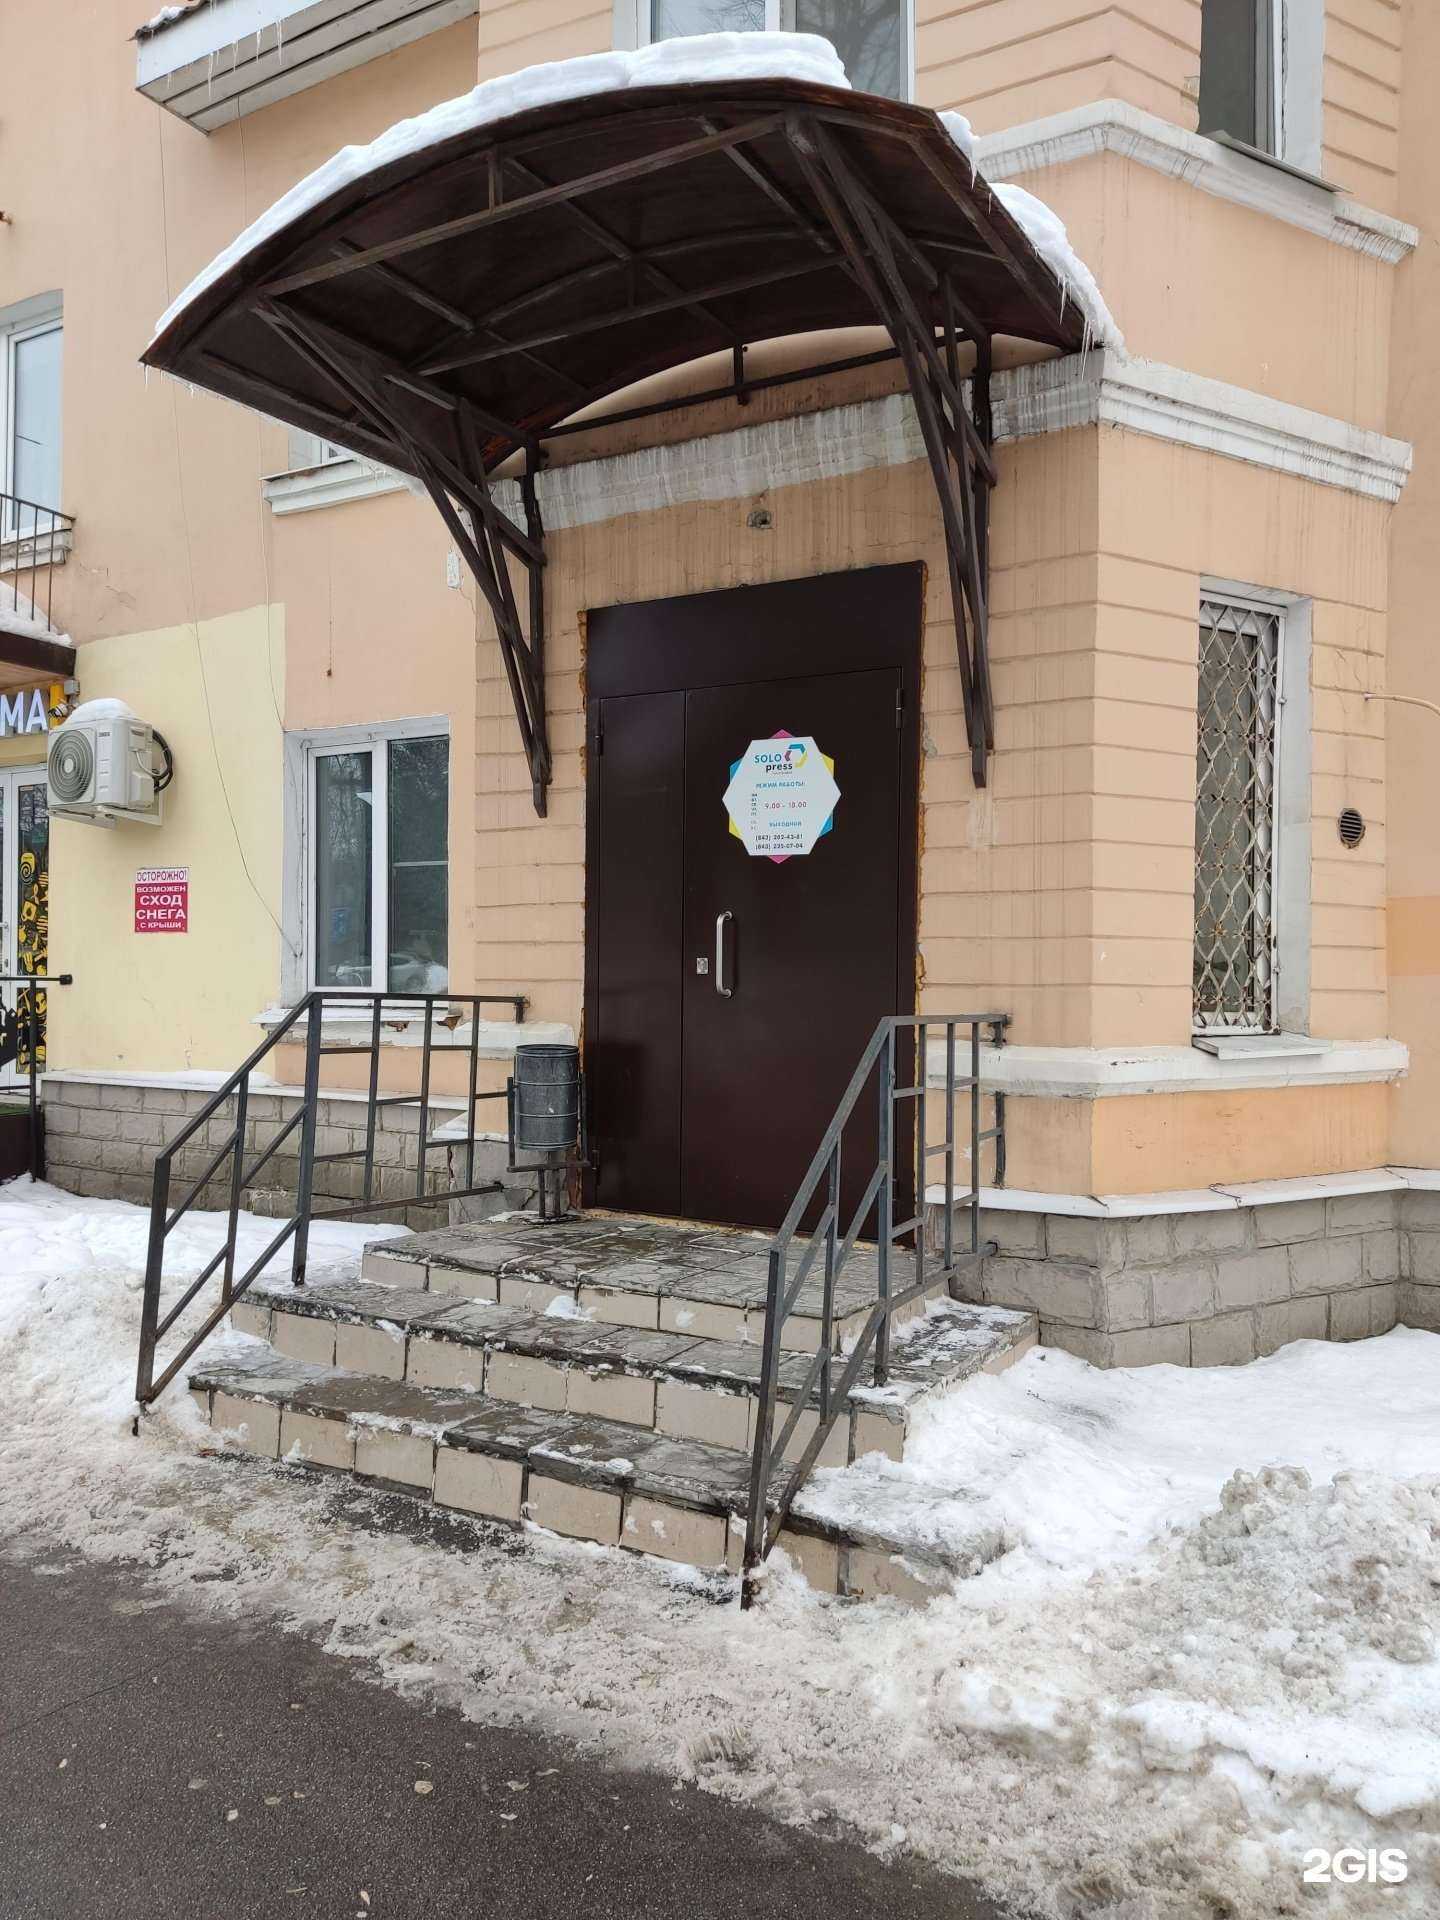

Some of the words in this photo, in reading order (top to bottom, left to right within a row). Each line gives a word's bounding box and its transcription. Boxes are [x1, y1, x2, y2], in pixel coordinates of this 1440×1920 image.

[754, 753, 782, 763] SOLO
[766, 763, 793, 773] press
[136, 870, 187, 881] ОСТОРОЖНО!
[136, 885, 186, 893] ВОЗМОЖЕН
[140, 894, 183, 908] СХОД
[136, 908, 186, 920] СНЕГА
[148, 921, 182, 929] КРЫШИ
